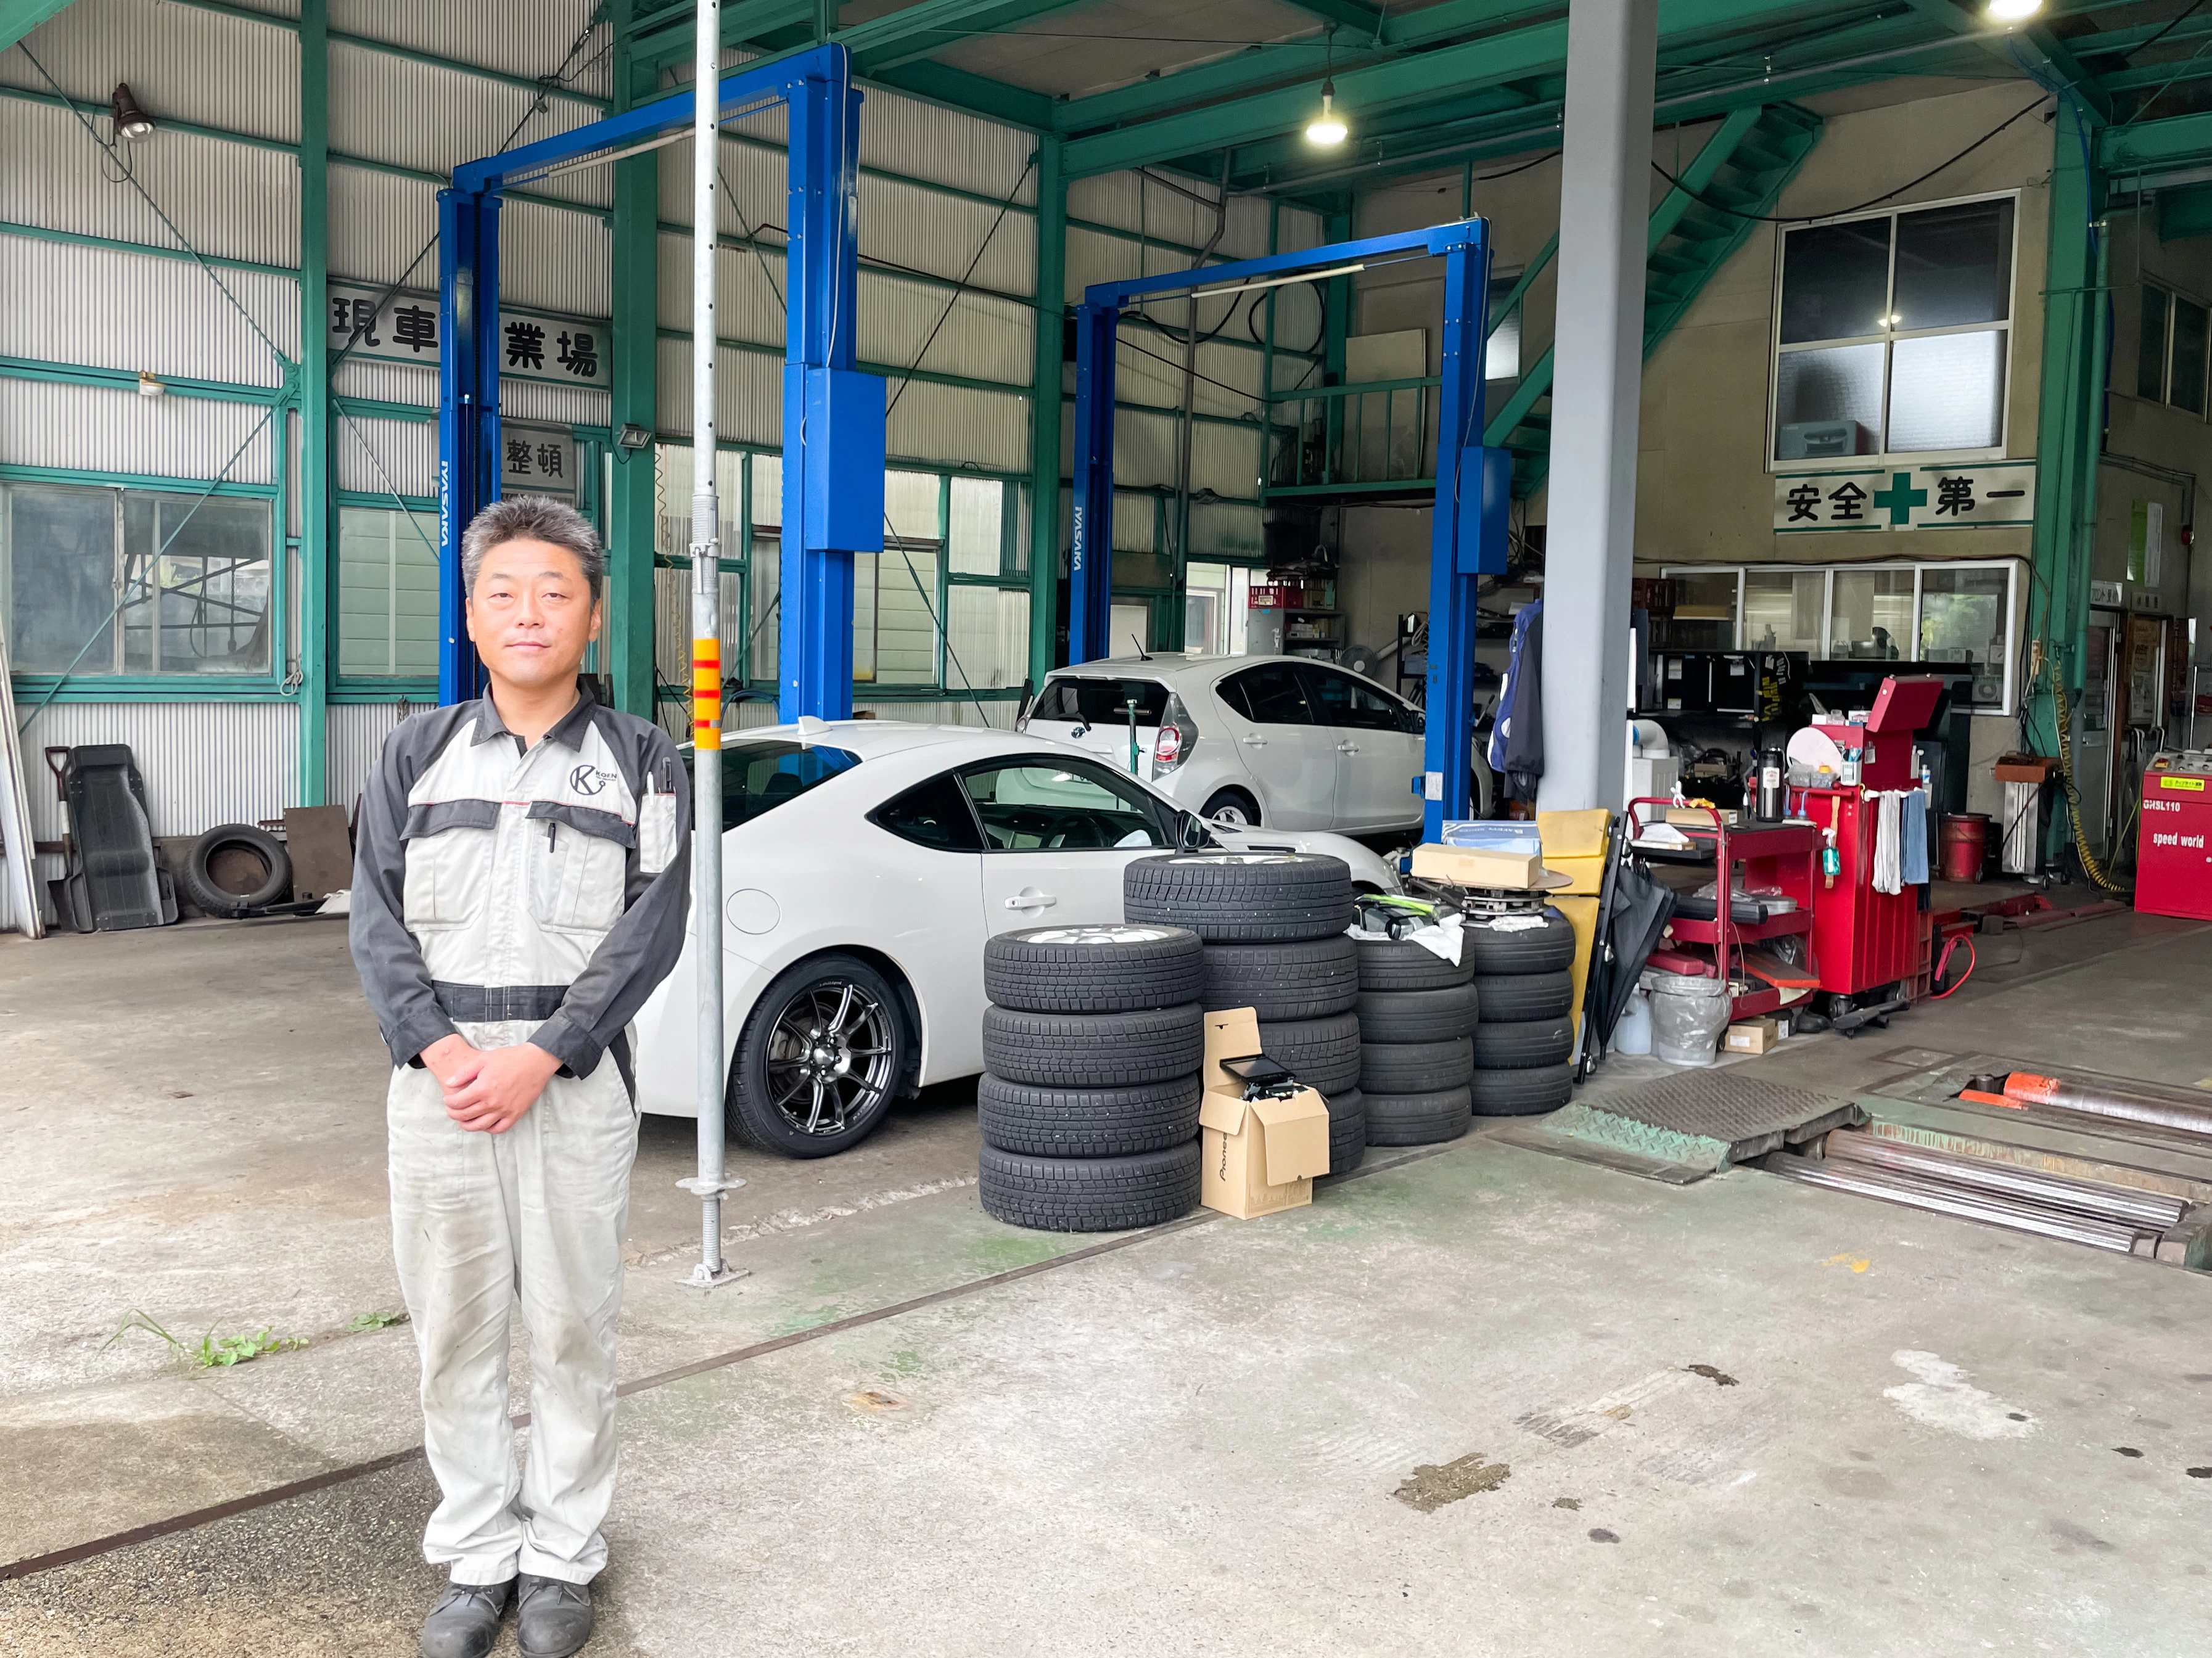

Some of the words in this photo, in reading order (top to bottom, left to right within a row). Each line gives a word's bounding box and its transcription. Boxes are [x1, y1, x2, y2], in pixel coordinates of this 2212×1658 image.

[332, 297, 599, 378] 現車業場
[501, 439, 564, 479] 整頓
[1785, 481, 1868, 523] 安全
[1934, 475, 2026, 517] 第一
[1074, 507, 1082, 571] IYASAKA
[595, 770, 617, 779] KOEN
[2153, 832, 2177, 847] speed
[2181, 834, 2205, 849] world
